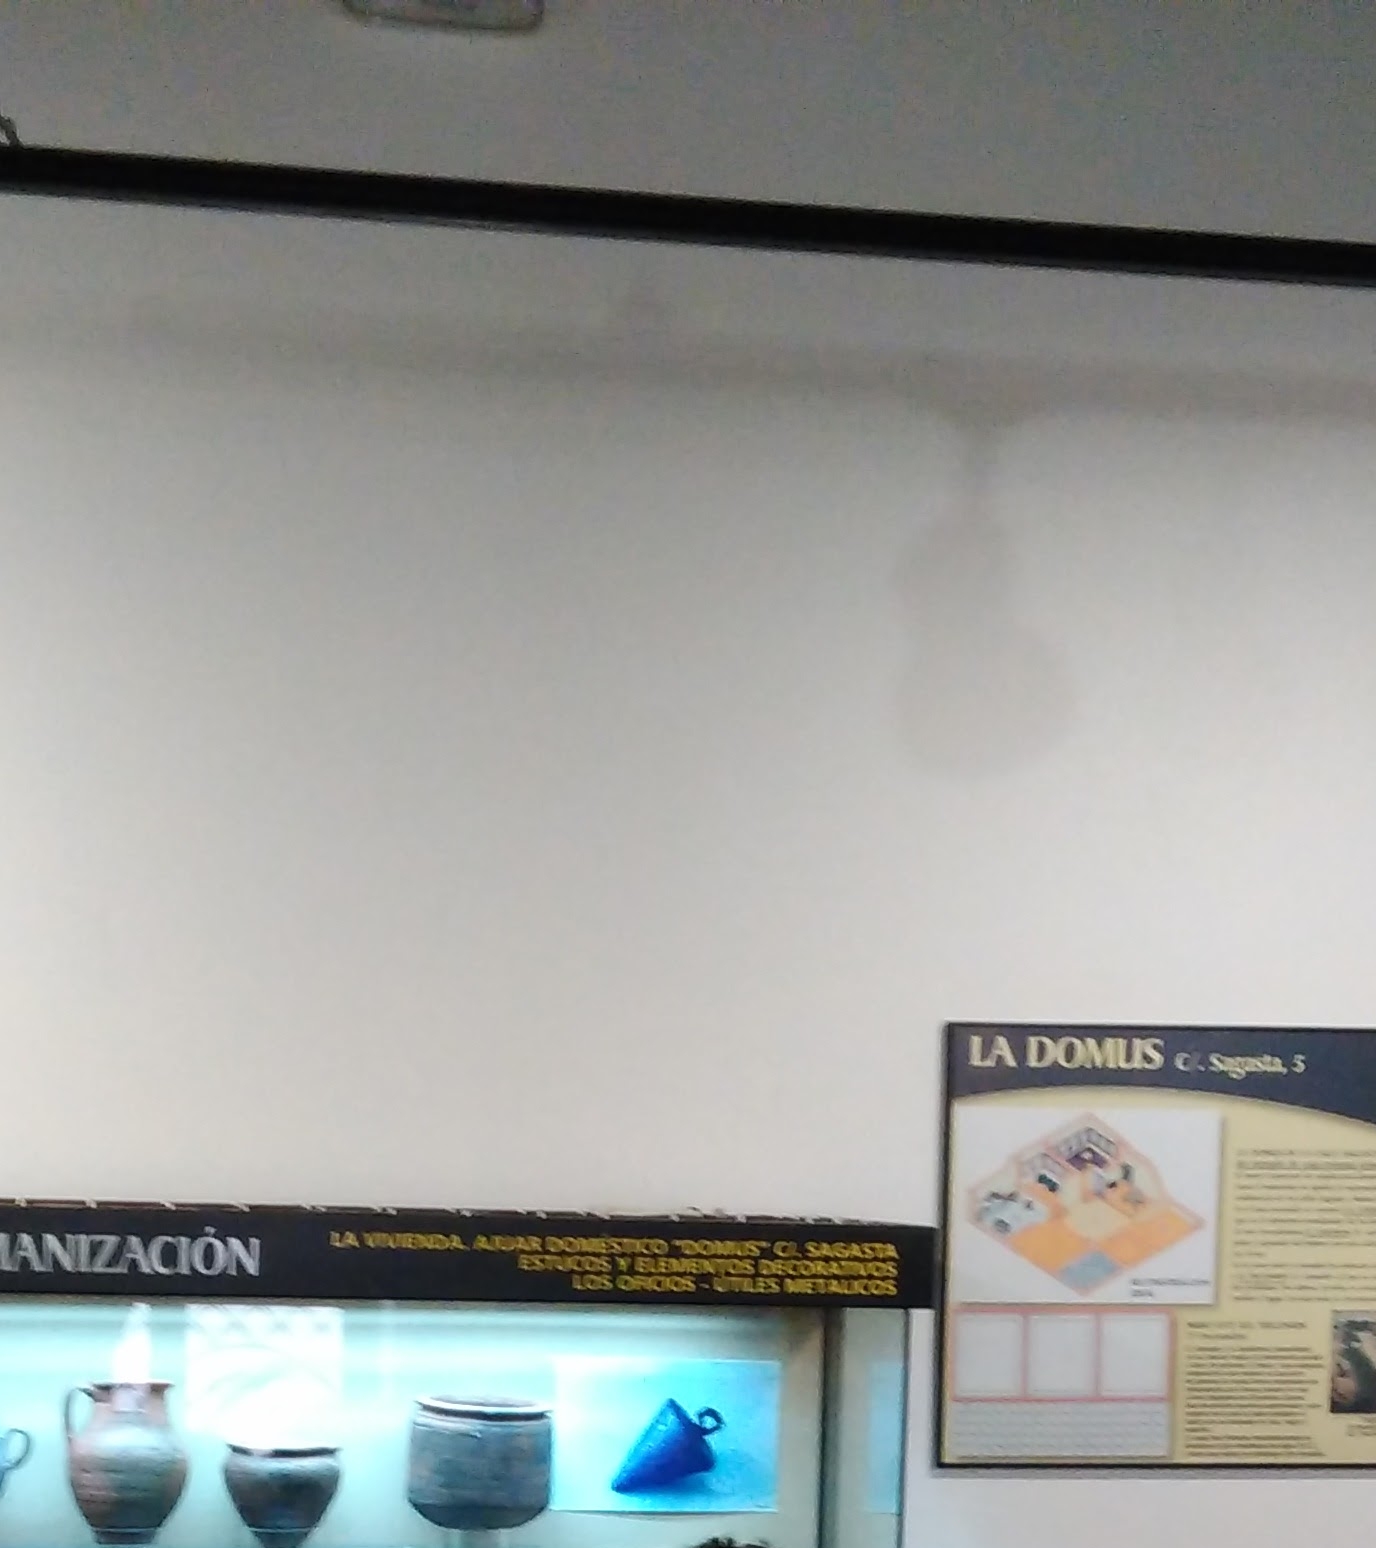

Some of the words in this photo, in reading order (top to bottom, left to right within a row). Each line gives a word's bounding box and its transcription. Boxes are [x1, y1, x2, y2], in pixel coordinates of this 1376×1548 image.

[968, 1035, 1018, 1068] LA
[1026, 1036, 1164, 1070] DOMUS
[330, 1231, 360, 1249] LA
[804, 1241, 900, 1260] SAGASTA
[518, 1254, 612, 1273] ESTUCOS
[634, 1257, 756, 1275] ELEMENTOS
[758, 1258, 898, 1277] DECORATIVOS
[572, 1274, 614, 1291] LOS
